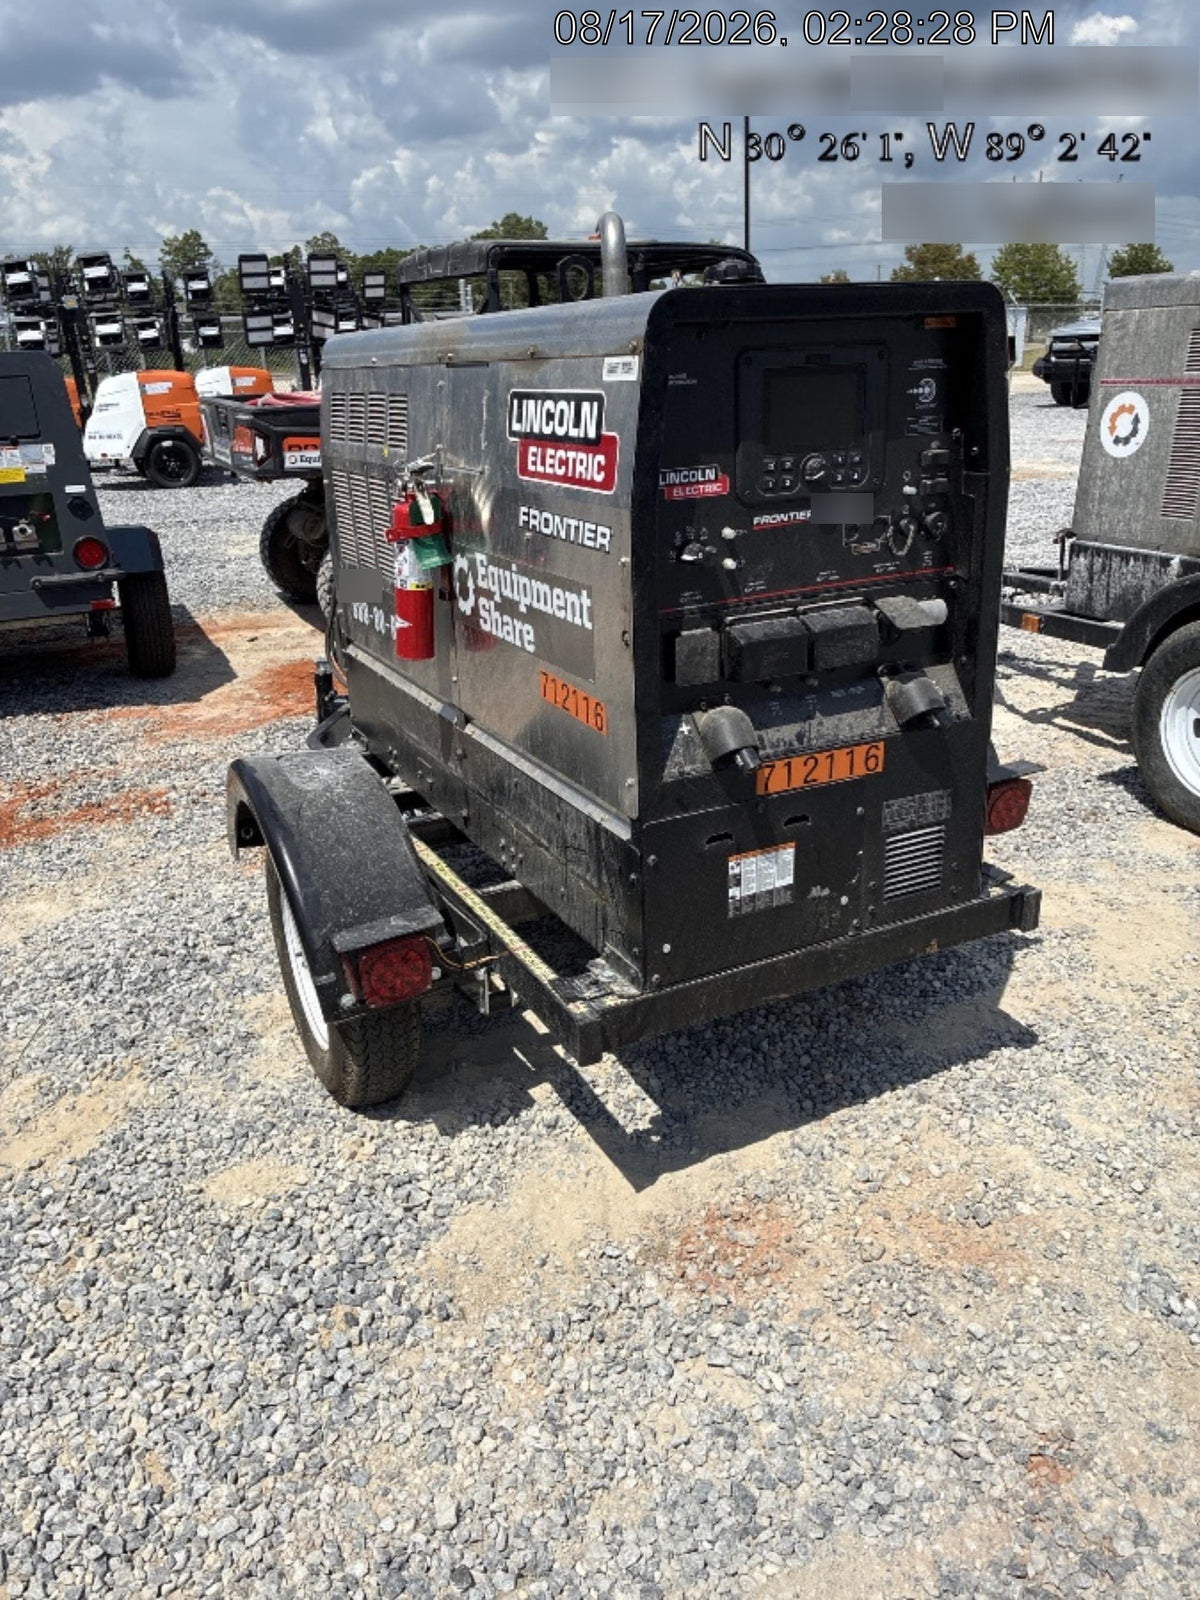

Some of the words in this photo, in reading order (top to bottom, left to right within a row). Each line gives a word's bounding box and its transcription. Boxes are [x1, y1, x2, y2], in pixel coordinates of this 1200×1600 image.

[511, 398, 598, 439] LINCOLN
[527, 445, 605, 483] ELECTRIC
[659, 467, 716, 486] LINCOLN
[673, 482, 723, 497] ELECTRIC
[518, 505, 612, 553] FRONTIER
[475, 552, 593, 630] Equipment
[478, 596, 536, 653] Share
[541, 671, 603, 731] 712116
[763, 744, 881, 791] 712116
